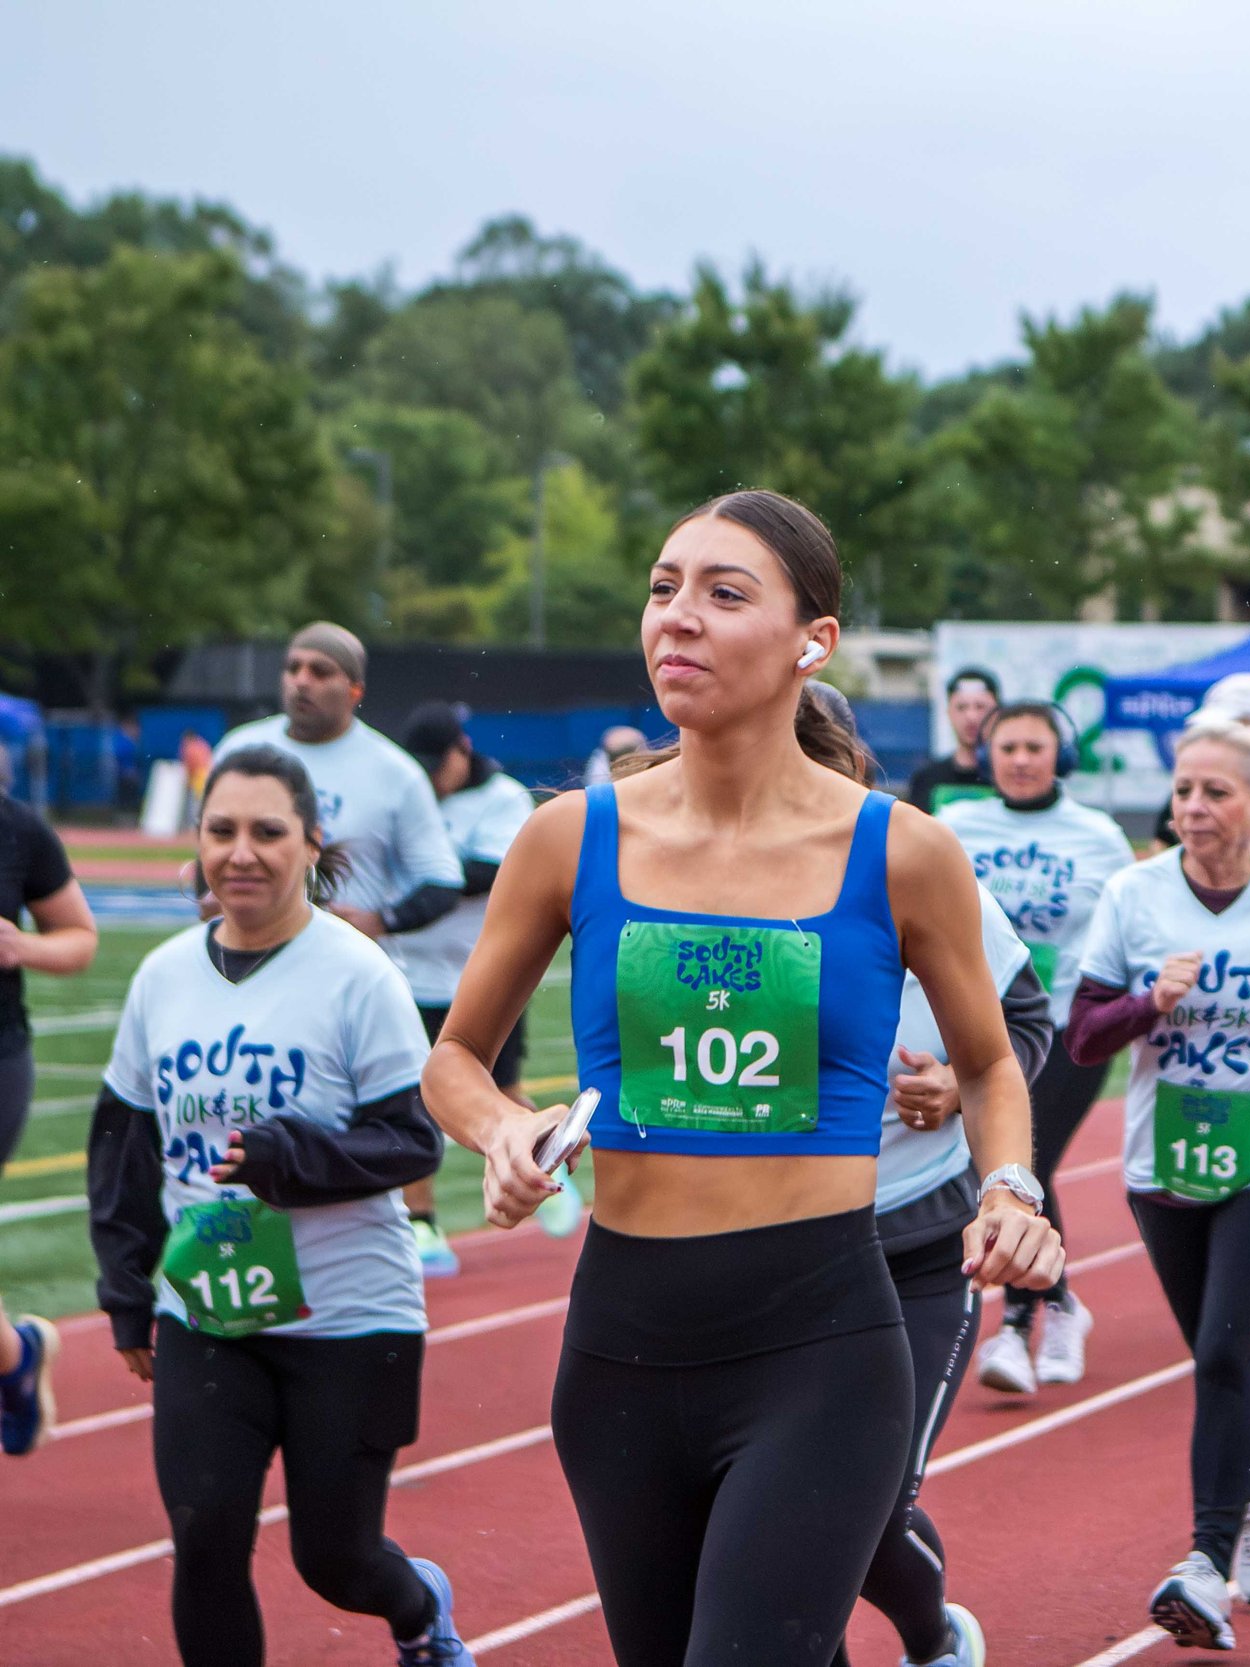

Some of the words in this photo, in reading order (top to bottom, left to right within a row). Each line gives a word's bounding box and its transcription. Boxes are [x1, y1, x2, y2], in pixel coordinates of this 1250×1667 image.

[974, 841, 1075, 888] SOUTH
[676, 936, 763, 969] SOUTH
[676, 962, 762, 993] LAKES
[706, 990, 731, 1011] 5K
[158, 1024, 306, 1108] SOUTH
[660, 1027, 780, 1087] 102
[1171, 1138, 1238, 1179] 113
[190, 1265, 279, 1310] 112
